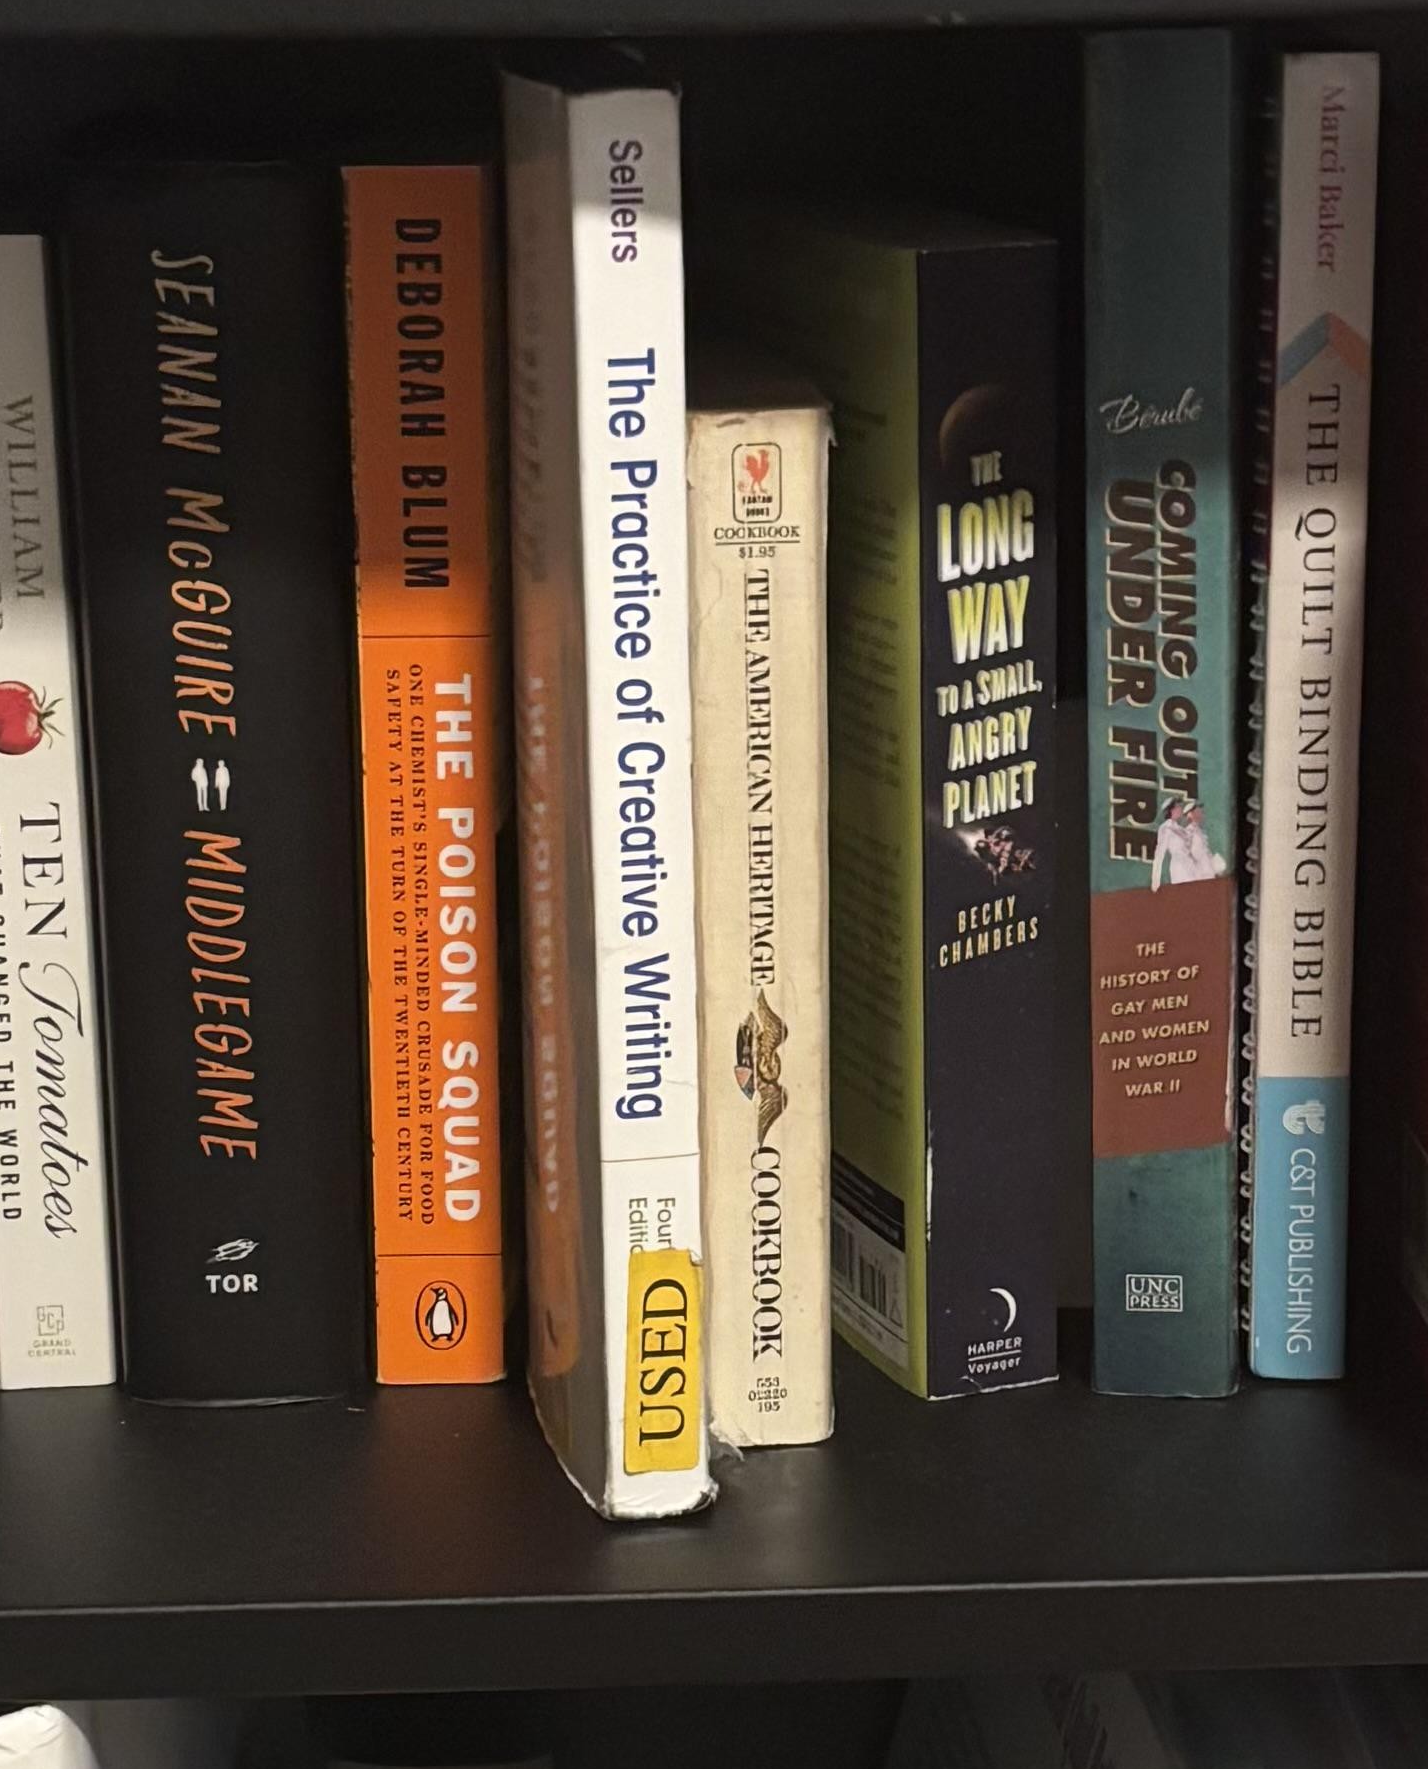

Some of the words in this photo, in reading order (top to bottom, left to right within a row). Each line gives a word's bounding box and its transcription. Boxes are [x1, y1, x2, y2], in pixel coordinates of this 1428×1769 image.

[608, 139, 643, 264] Sellers
[395, 217, 446, 438] DEBORAH
[4, 395, 44, 600] WILLIAM
[1306, 384, 1340, 486] THE
[402, 464, 451, 590] BLUM
[1105, 479, 1157, 709] UNDER
[1156, 459, 1198, 680] COMING
[1295, 508, 1337, 655] QUILT
[942, 762, 1036, 829] PLANET
[1108, 725, 1156, 864] FIRE
[1159, 695, 1198, 804] OUT
[1294, 677, 1332, 886] BINDING
[184, 830, 260, 1161] MIDDLEGAME
[1290, 908, 1325, 1037] BIBLE
[1289, 1148, 1316, 1197] C&T
[1285, 1205, 1315, 1353] PUBLISHING
[636, 1278, 690, 1448] USED
